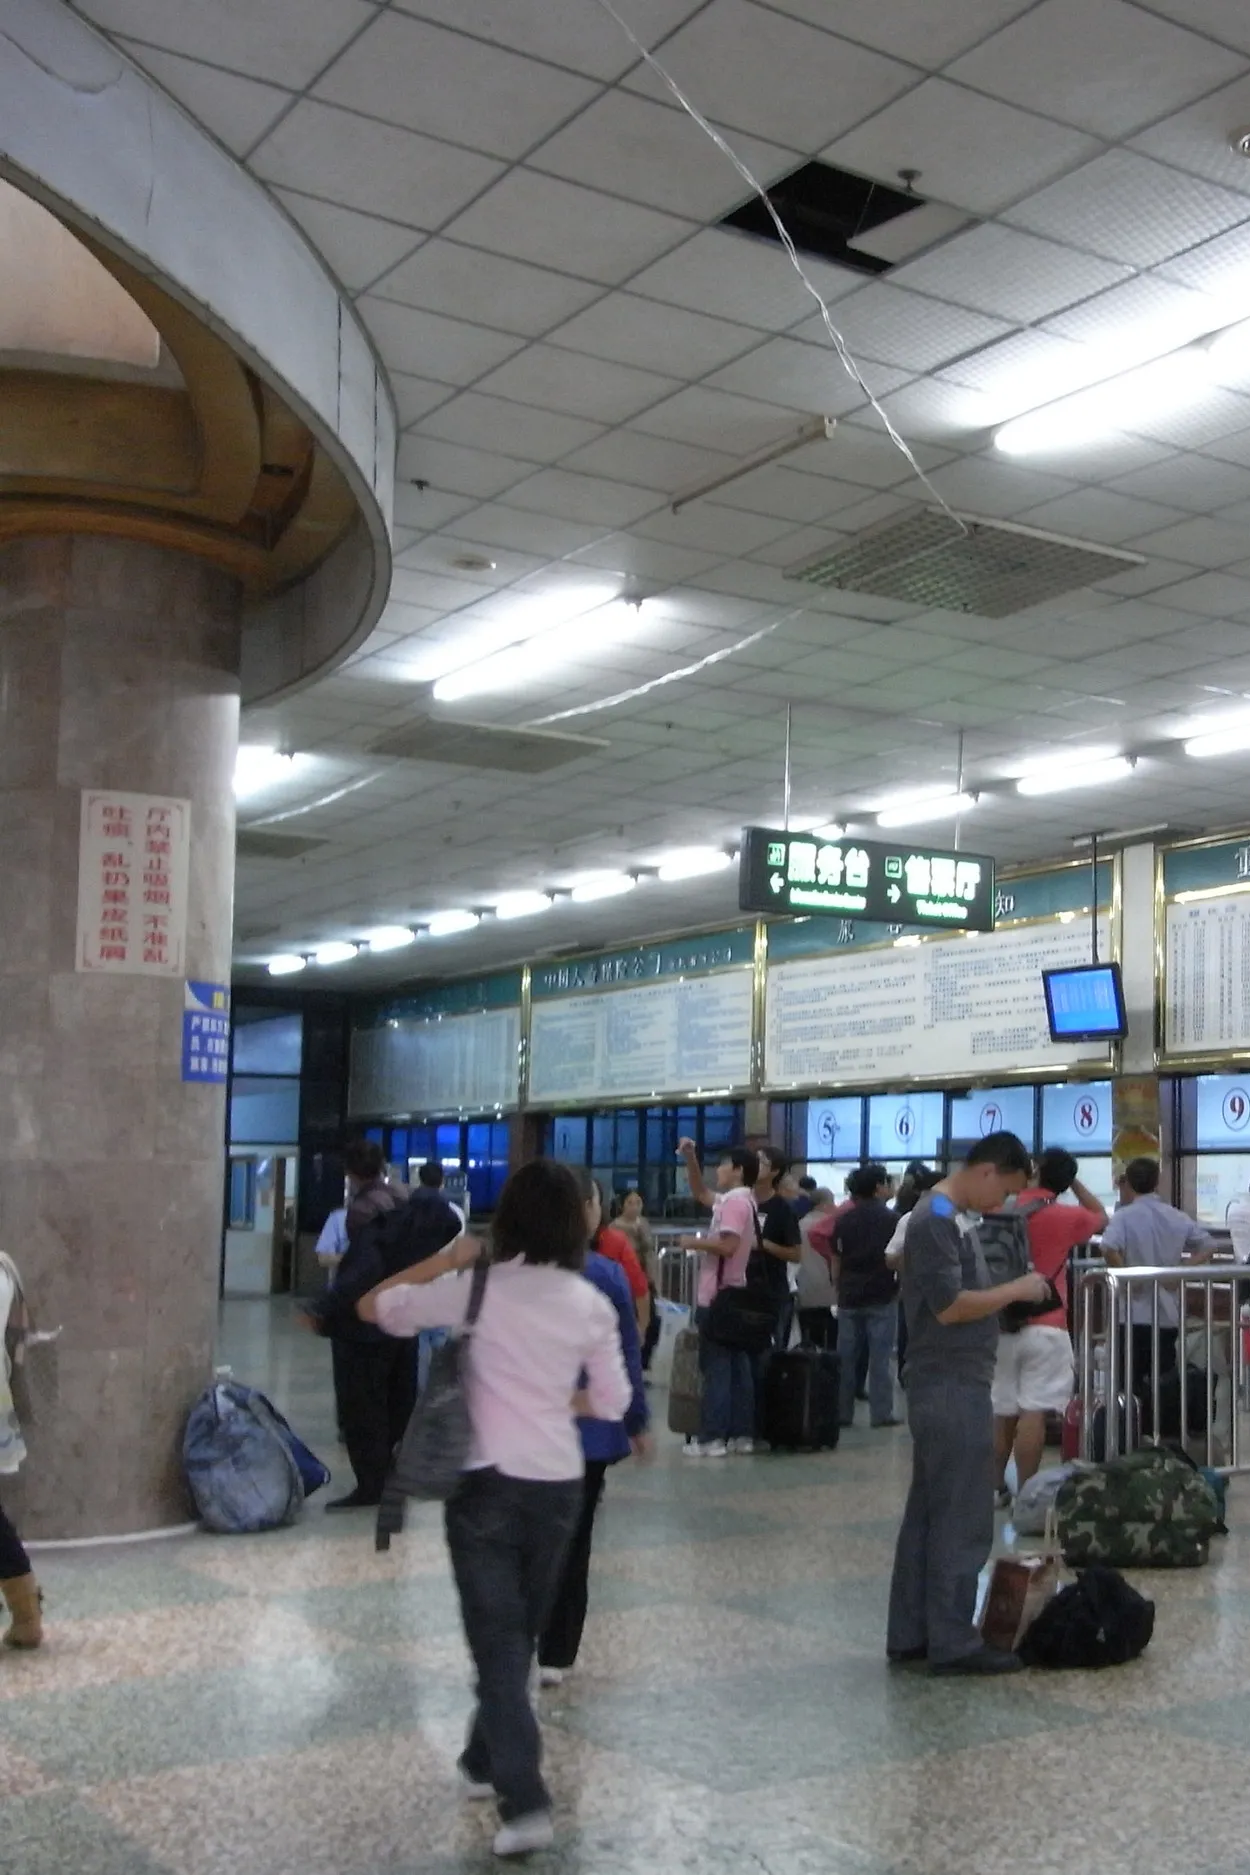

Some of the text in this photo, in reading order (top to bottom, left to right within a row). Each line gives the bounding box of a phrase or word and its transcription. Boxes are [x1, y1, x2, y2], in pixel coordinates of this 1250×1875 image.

[984, 1109, 997, 1133] 7
[1079, 1103, 1093, 1128] 8
[1229, 1095, 1245, 1123] 9
[898, 1114, 910, 1136] 6
